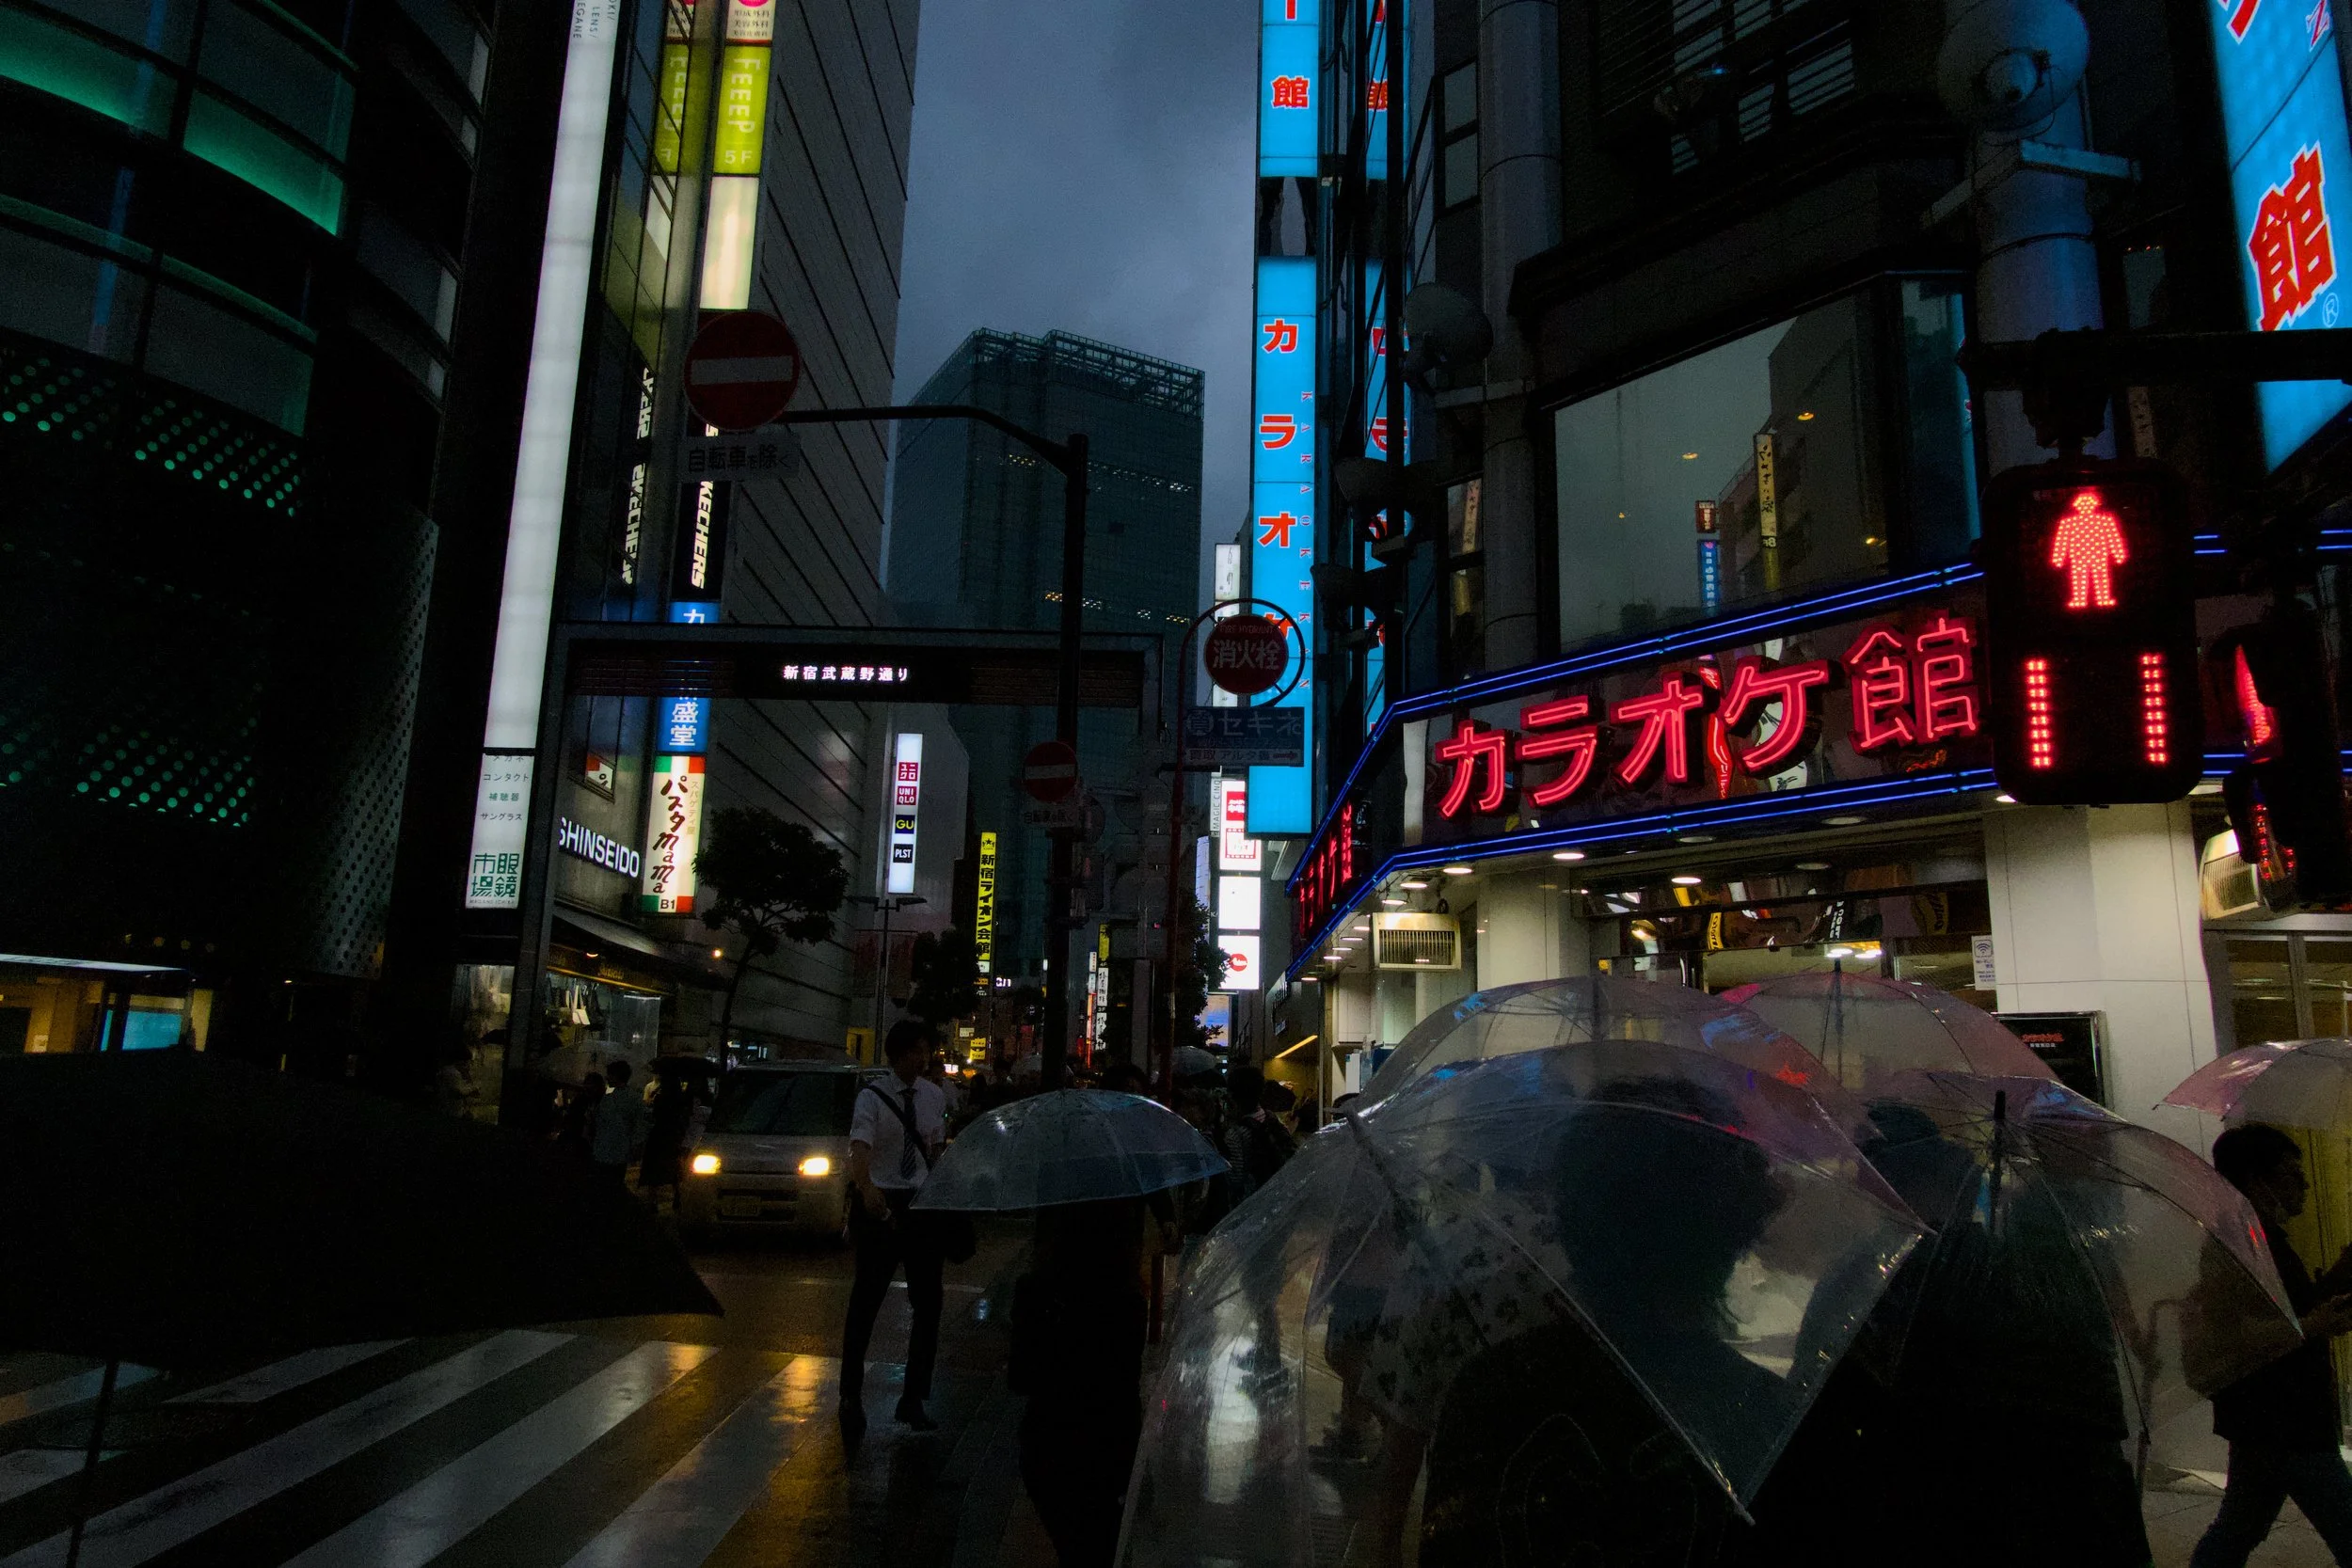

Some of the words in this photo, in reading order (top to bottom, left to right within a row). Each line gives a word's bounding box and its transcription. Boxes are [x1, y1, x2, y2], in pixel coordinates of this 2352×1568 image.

[573, 0, 585, 38] EGANE
[727, 58, 761, 134] FEEEP
[724, 150, 753, 165] 5F
[690, 444, 792, 472] 自転車を除く
[691, 481, 715, 590] KECHERS
[1213, 640, 1280, 670] 消火栓
[783, 665, 909, 682] 新宿武蔵野通り
[1432, 615, 1979, 820] カラオケ館
[483, 772, 530, 782] コンタクト
[480, 813, 523, 821] サングラス
[896, 820, 914, 830] GU
[559, 816, 640, 879] SHINSEIDO
[895, 848, 912, 859] PLST
[660, 899, 675, 910] B1
